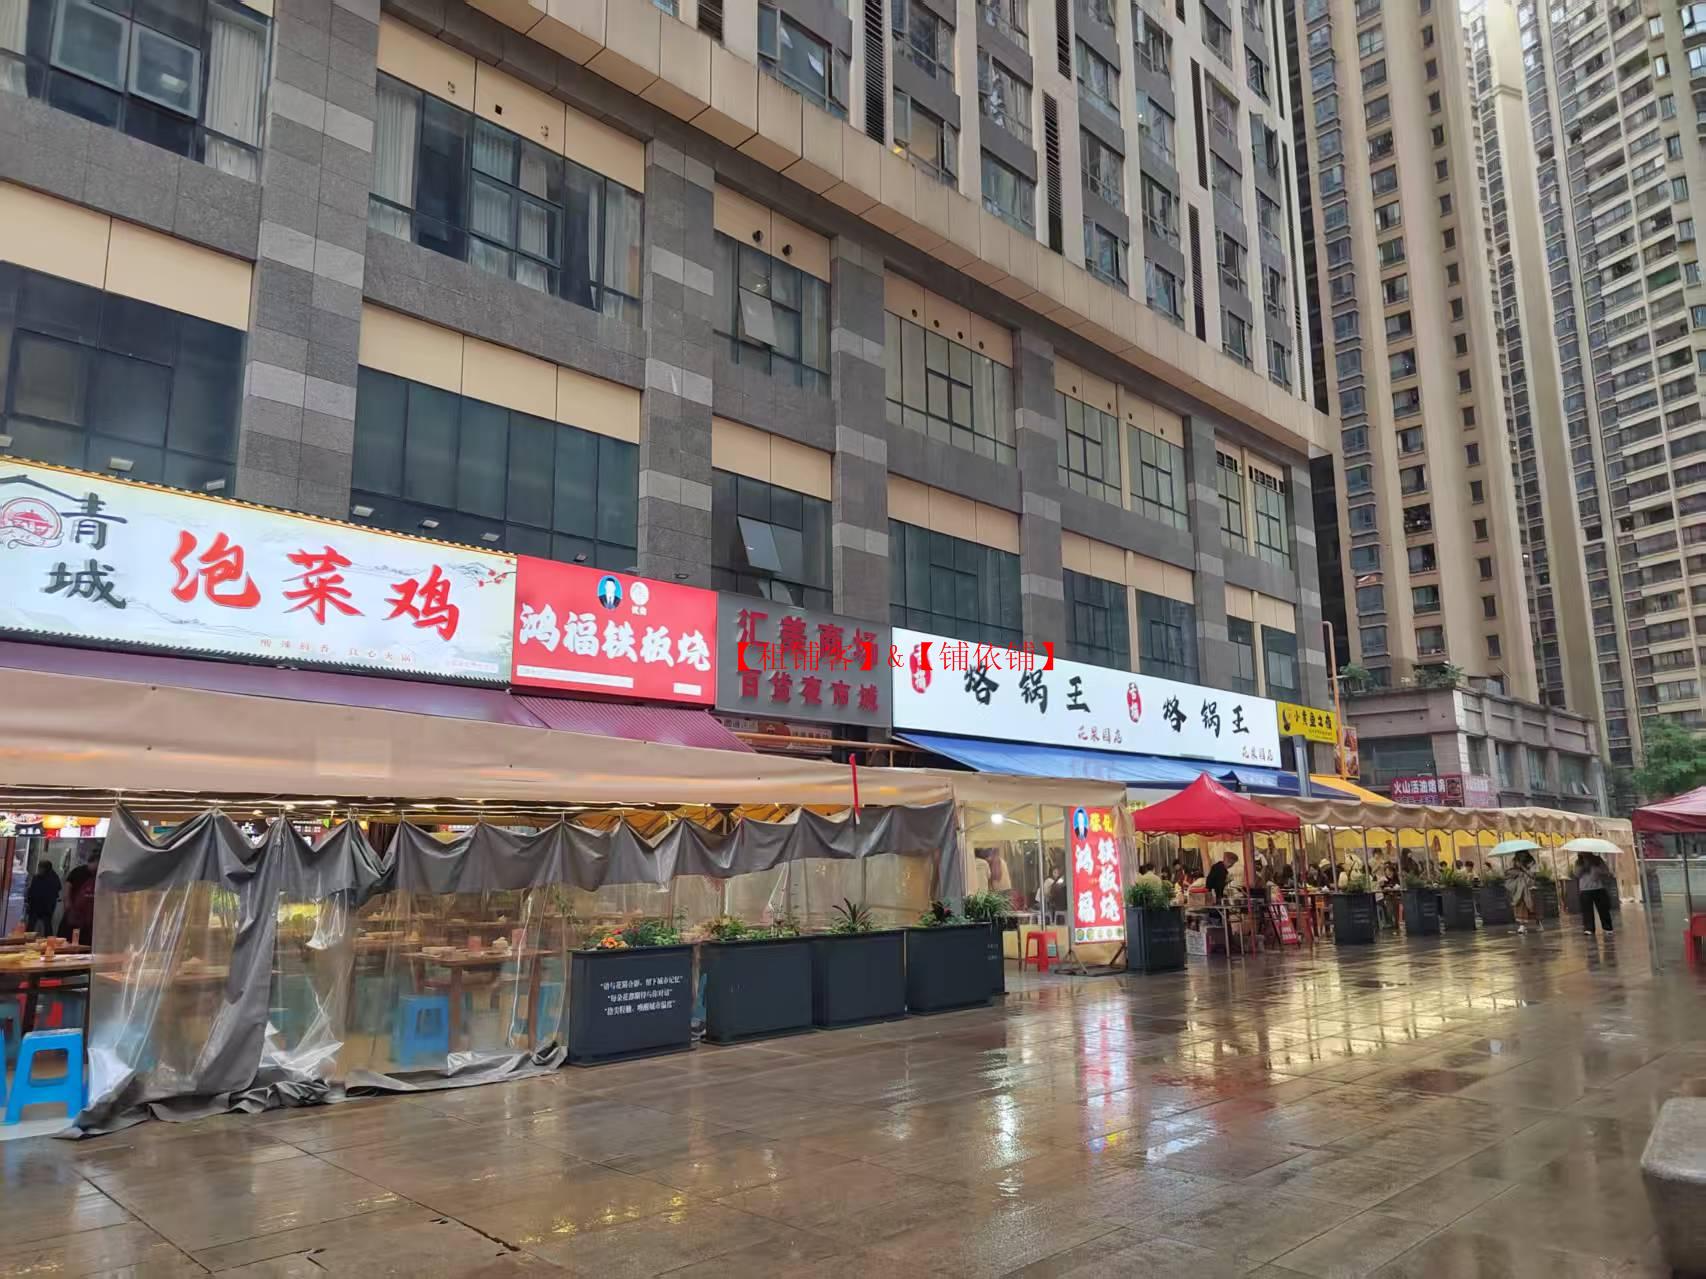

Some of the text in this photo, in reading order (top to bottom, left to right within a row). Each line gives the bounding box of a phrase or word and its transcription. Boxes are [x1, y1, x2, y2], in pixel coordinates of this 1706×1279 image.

[44, 492, 128, 609] 青城
[169, 530, 461, 641] 泡菜鸡
[519, 603, 711, 672] 鸿福铁板烧
[964, 662, 1091, 714] 烙锅王
[1162, 694, 1250, 739] 烙锅王
